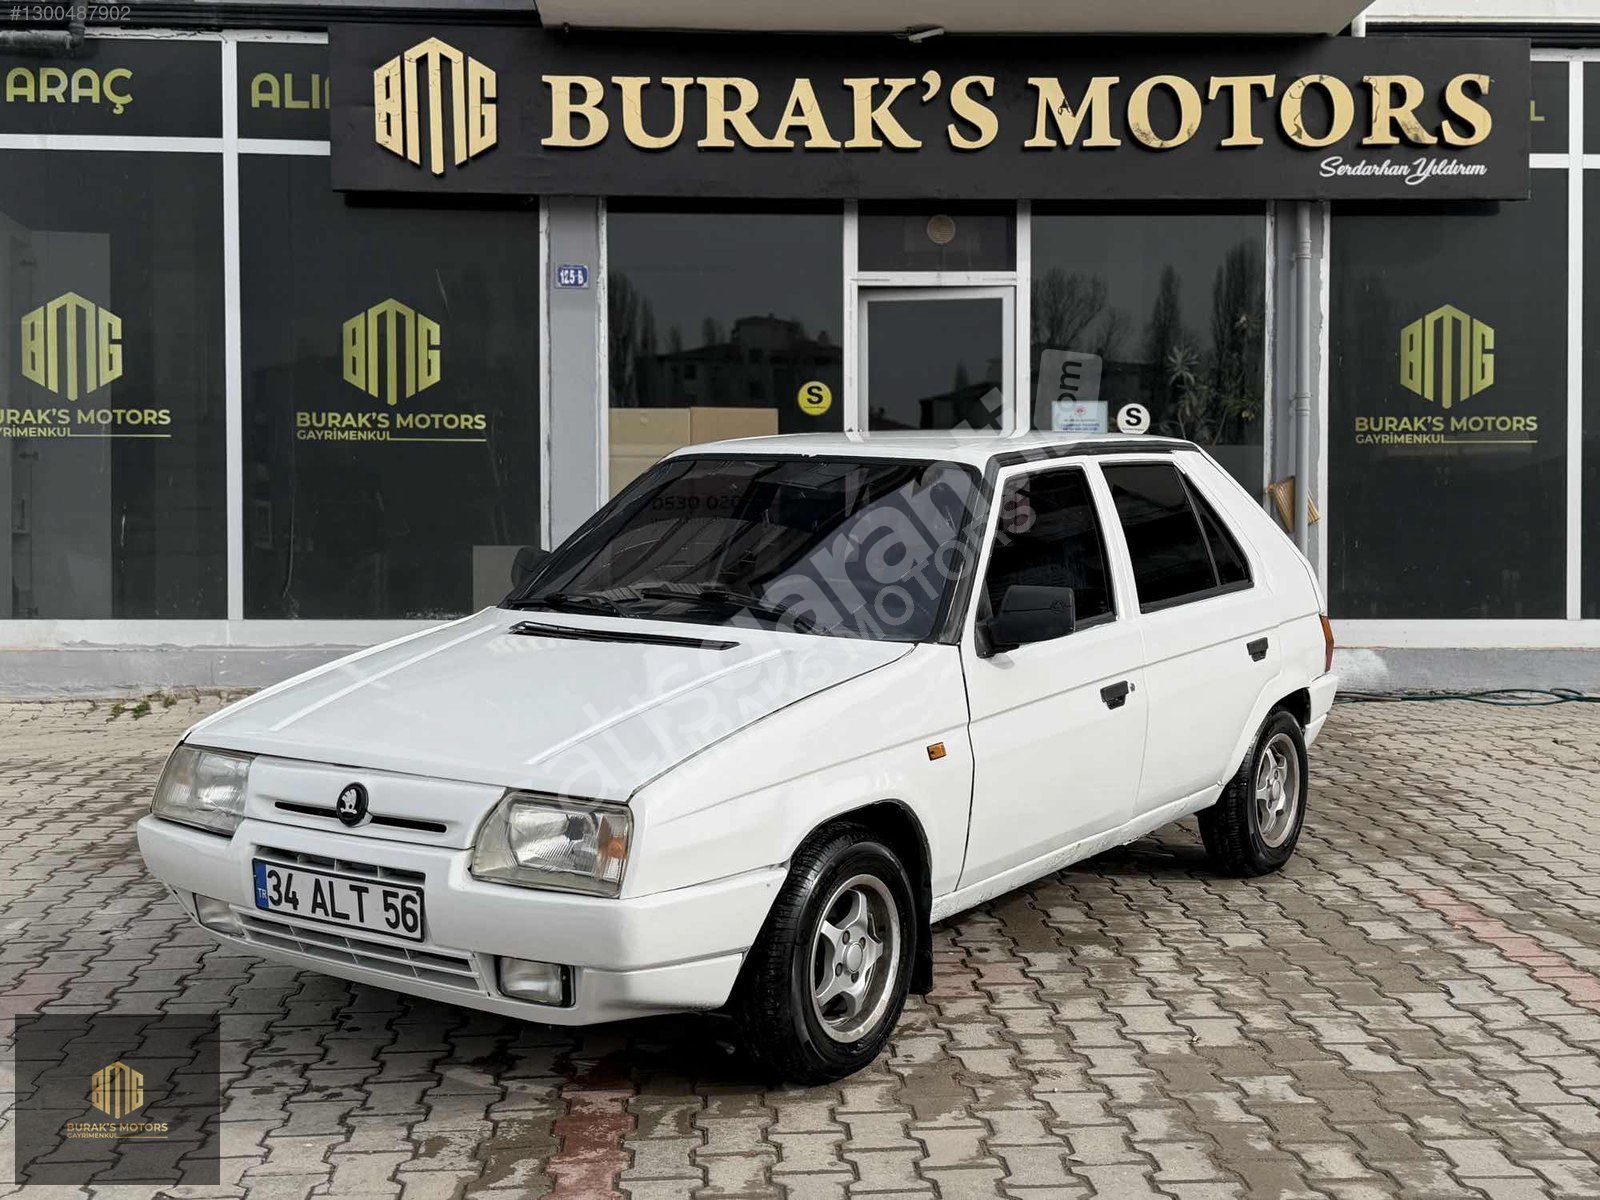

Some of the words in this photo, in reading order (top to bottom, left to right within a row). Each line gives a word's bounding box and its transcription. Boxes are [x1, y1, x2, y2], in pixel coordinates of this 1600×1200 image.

[6, 67, 133, 115] ARAÇ
[541, 70, 999, 149] BURAK'S
[1024, 73, 1493, 148] MOTORS
[1319, 155, 1410, 178] Serdarhan
[806, 385, 824, 405] S
[77, 408, 171, 425] MOTORS
[296, 412, 390, 428] BURAK'S
[396, 413, 487, 429] MOTORS
[1125, 407, 1142, 426] S
[1355, 415, 1445, 432] BURAK'S
[1450, 415, 1538, 432] MOTORS
[258, 887, 267, 898] TR
[267, 869, 299, 911] 34
[311, 878, 370, 924] ALT
[383, 889, 419, 933] 56
